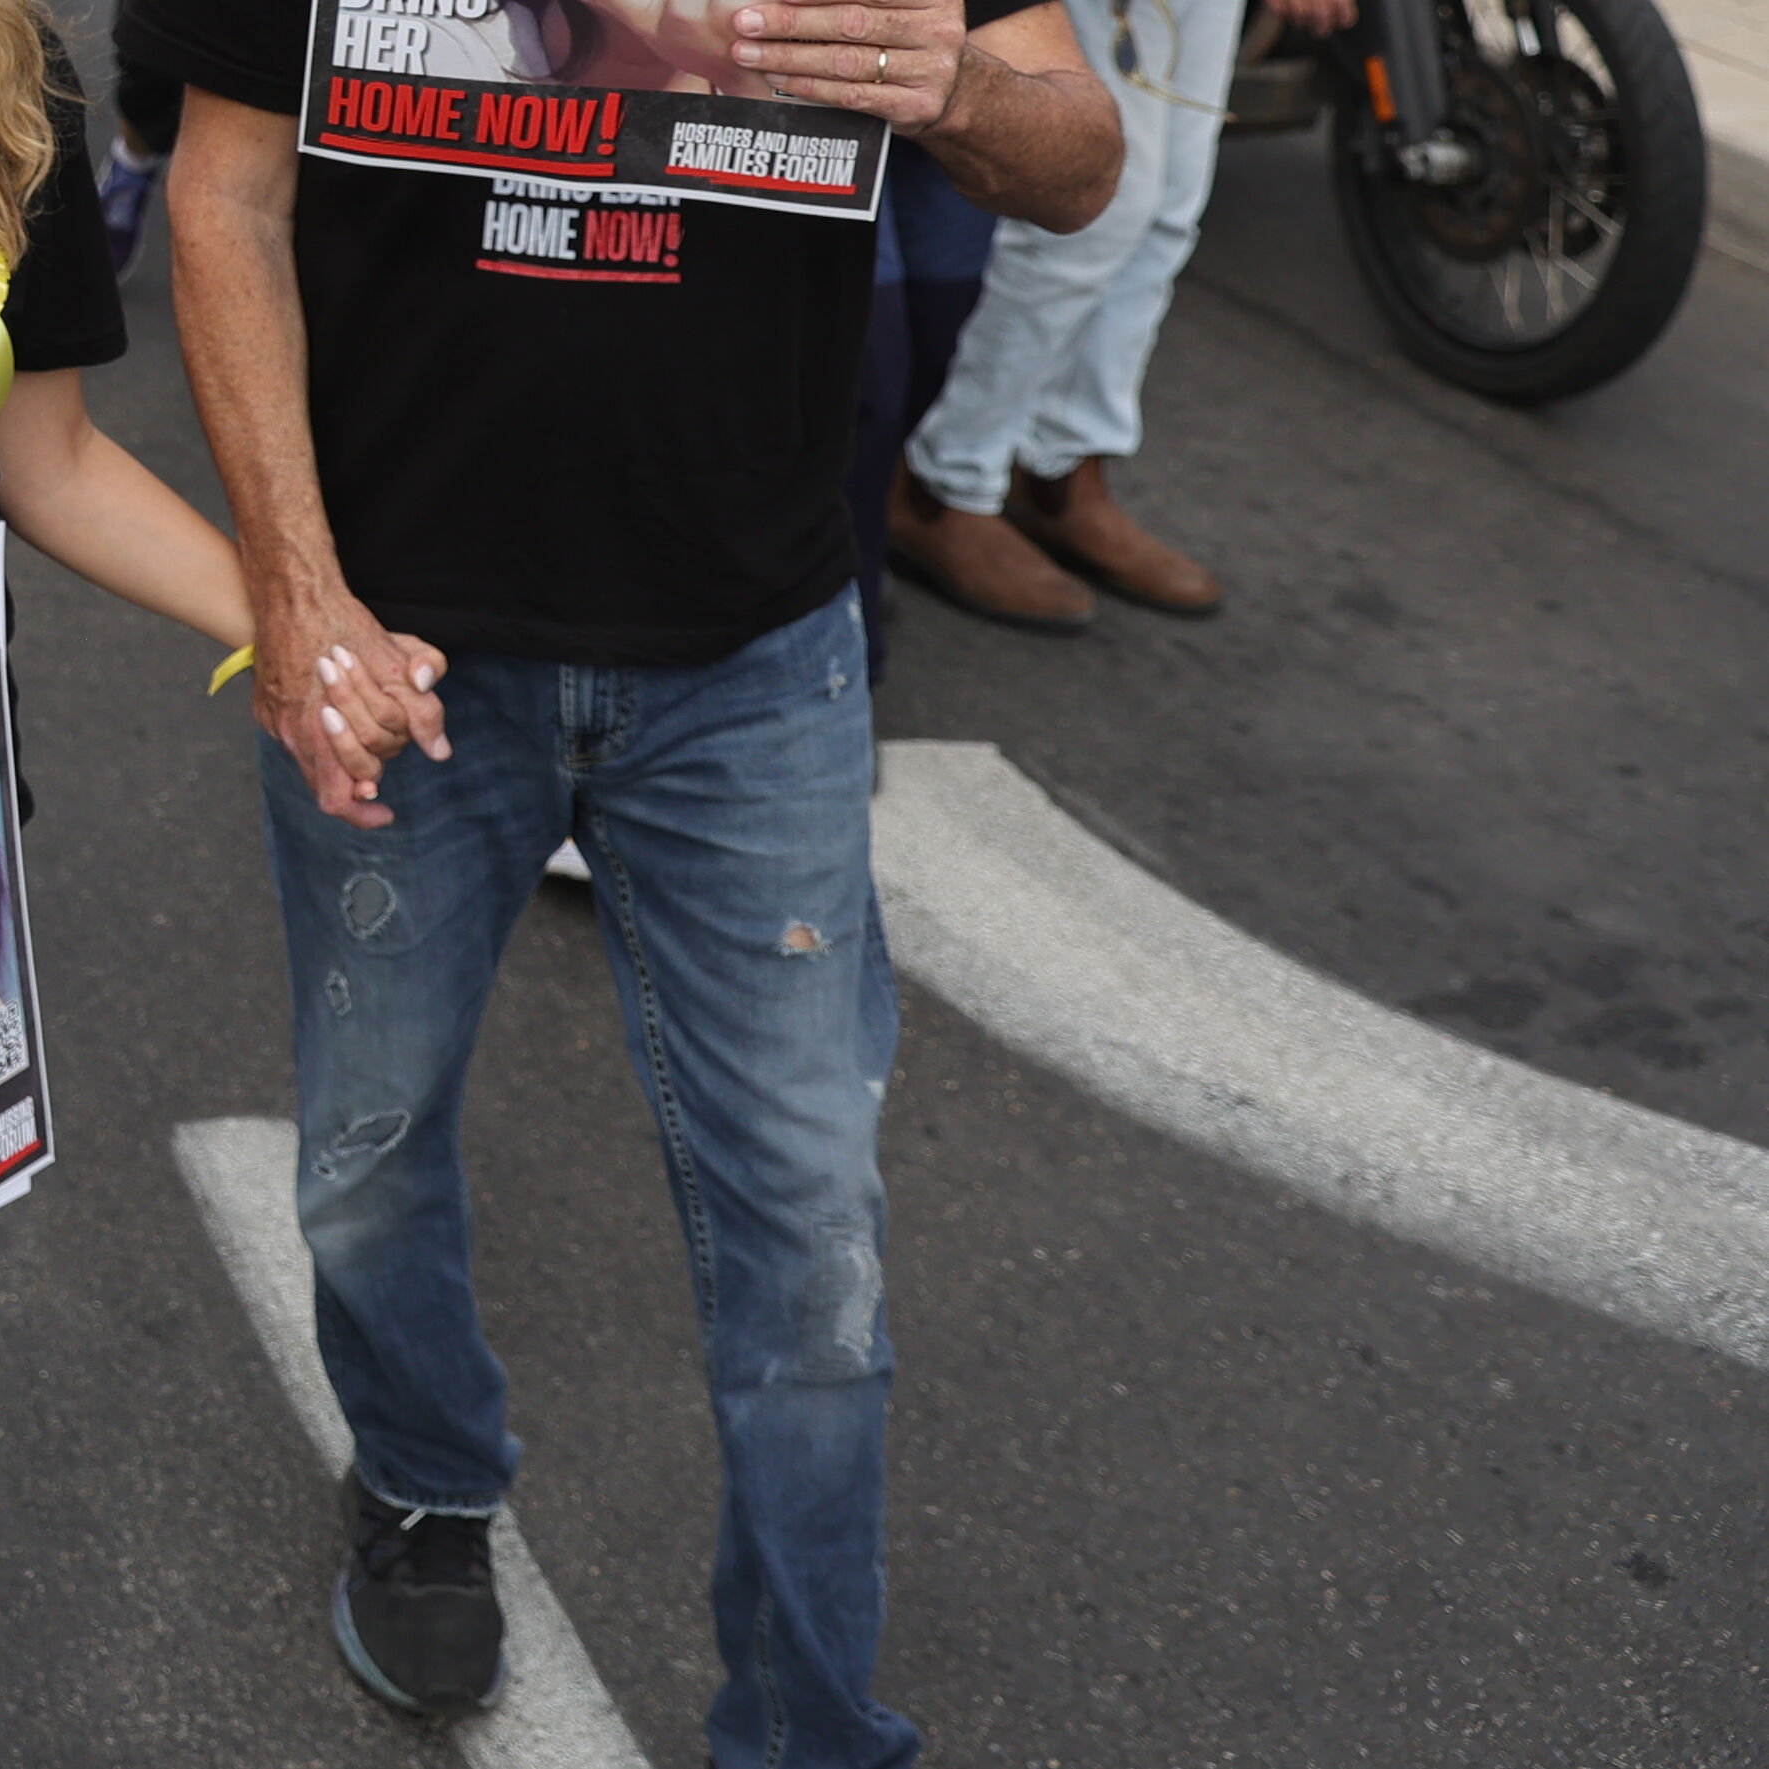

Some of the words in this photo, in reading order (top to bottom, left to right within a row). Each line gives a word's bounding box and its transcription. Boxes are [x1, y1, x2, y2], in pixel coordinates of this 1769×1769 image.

[331, 12, 429, 77] HER
[328, 75, 466, 136] HOME
[475, 92, 624, 156] NOW!
[673, 120, 754, 151] HOSTAGES
[754, 128, 789, 154] AND
[788, 131, 860, 161] MISSING
[668, 140, 771, 179] FAMILIES
[772, 152, 857, 188] FORUM
[481, 201, 577, 261] HOME
[582, 210, 685, 268] NOW!
